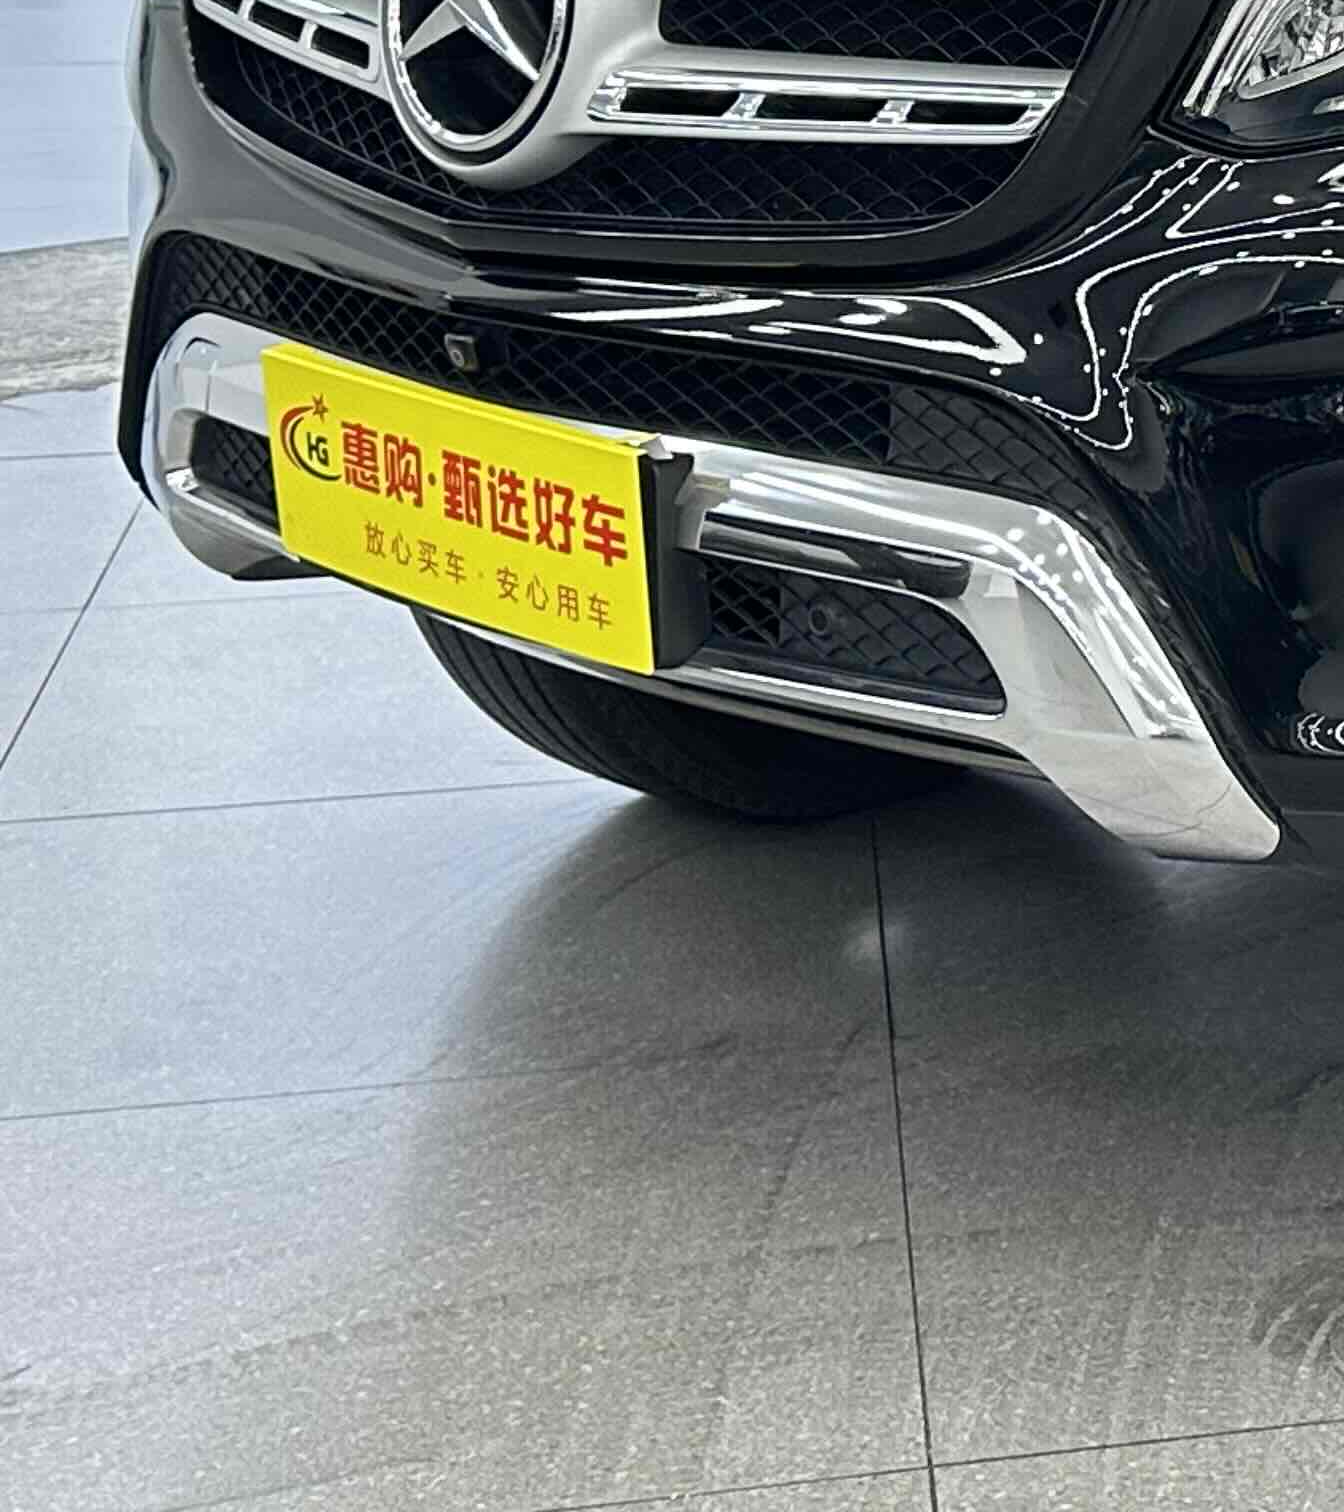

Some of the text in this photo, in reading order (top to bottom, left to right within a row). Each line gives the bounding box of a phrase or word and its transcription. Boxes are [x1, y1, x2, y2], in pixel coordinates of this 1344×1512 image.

[306, 431, 329, 467] HG
[341, 420, 628, 567] 惠购·甄选好车
